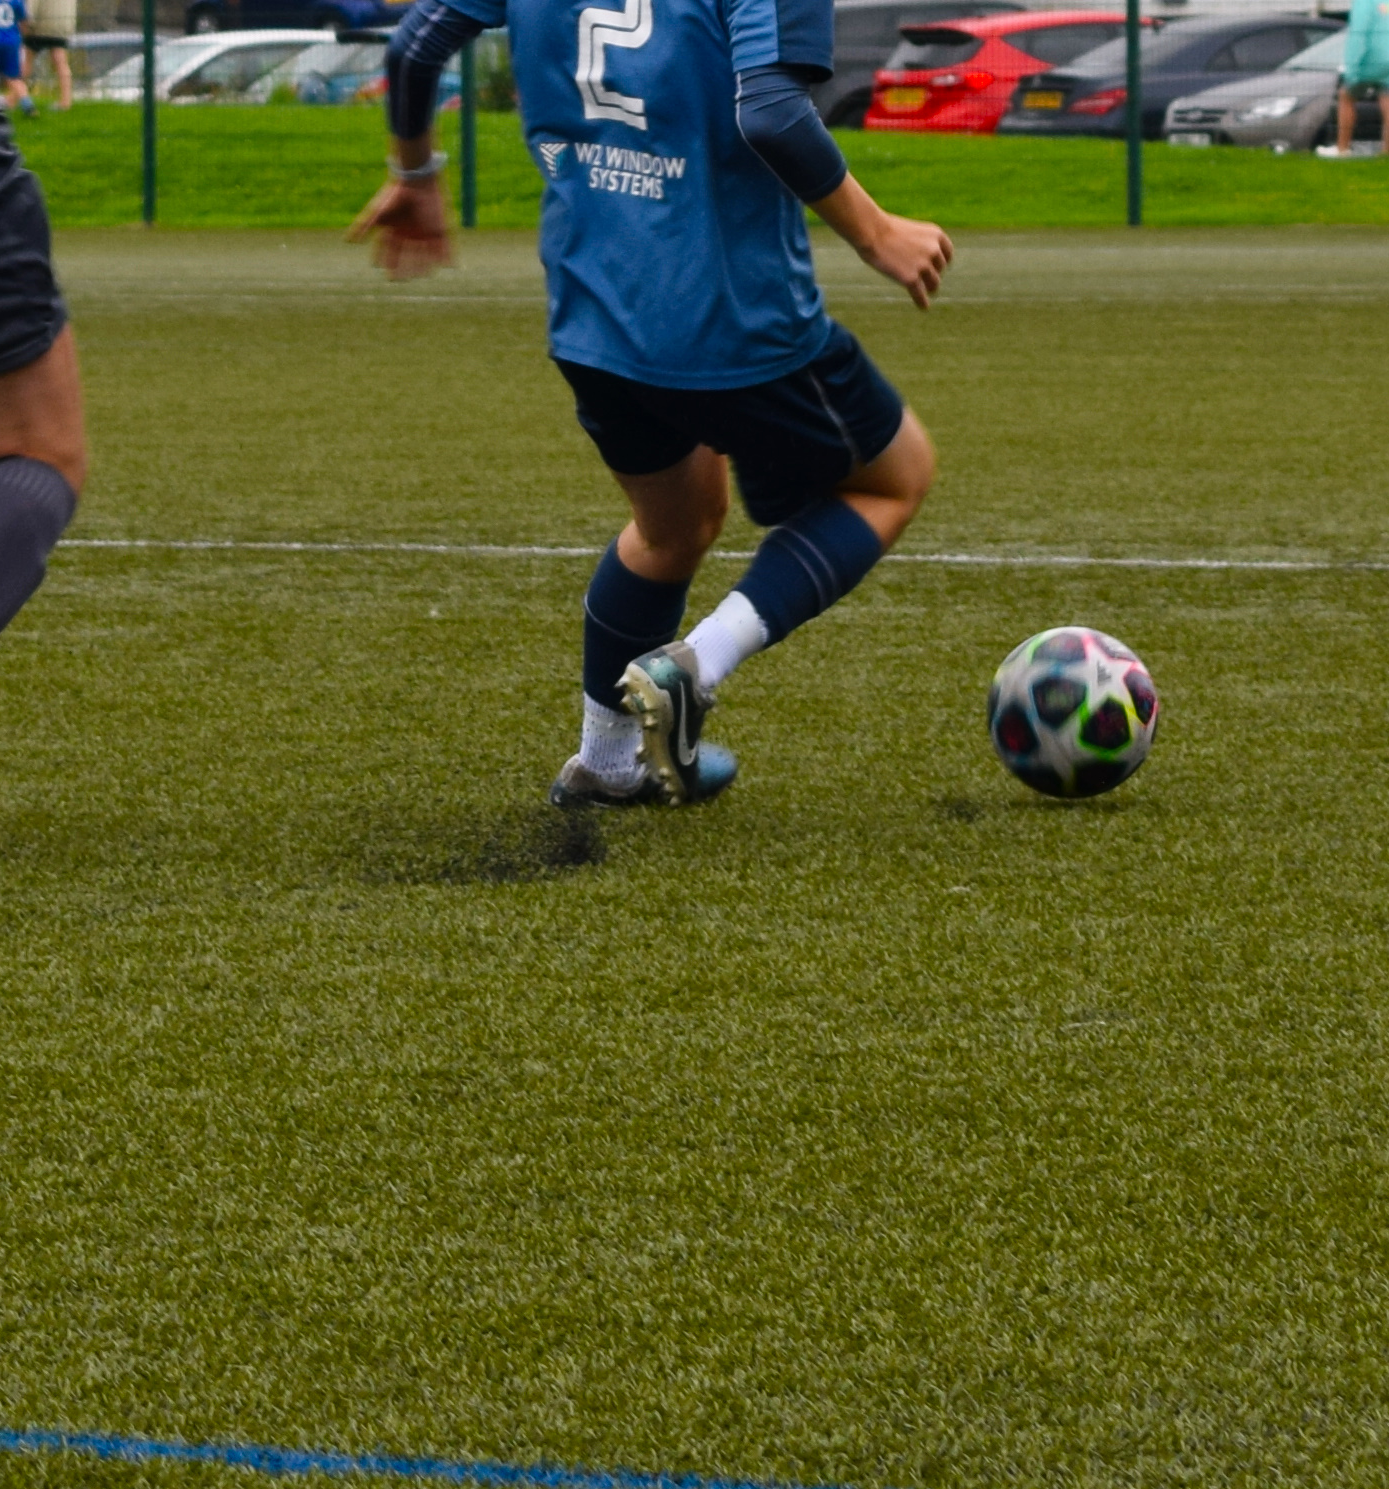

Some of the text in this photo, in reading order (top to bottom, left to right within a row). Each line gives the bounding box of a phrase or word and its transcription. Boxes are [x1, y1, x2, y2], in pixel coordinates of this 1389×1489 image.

[574, 142, 687, 179] W2 WINDOW
[589, 166, 664, 200] SYSTEMS
